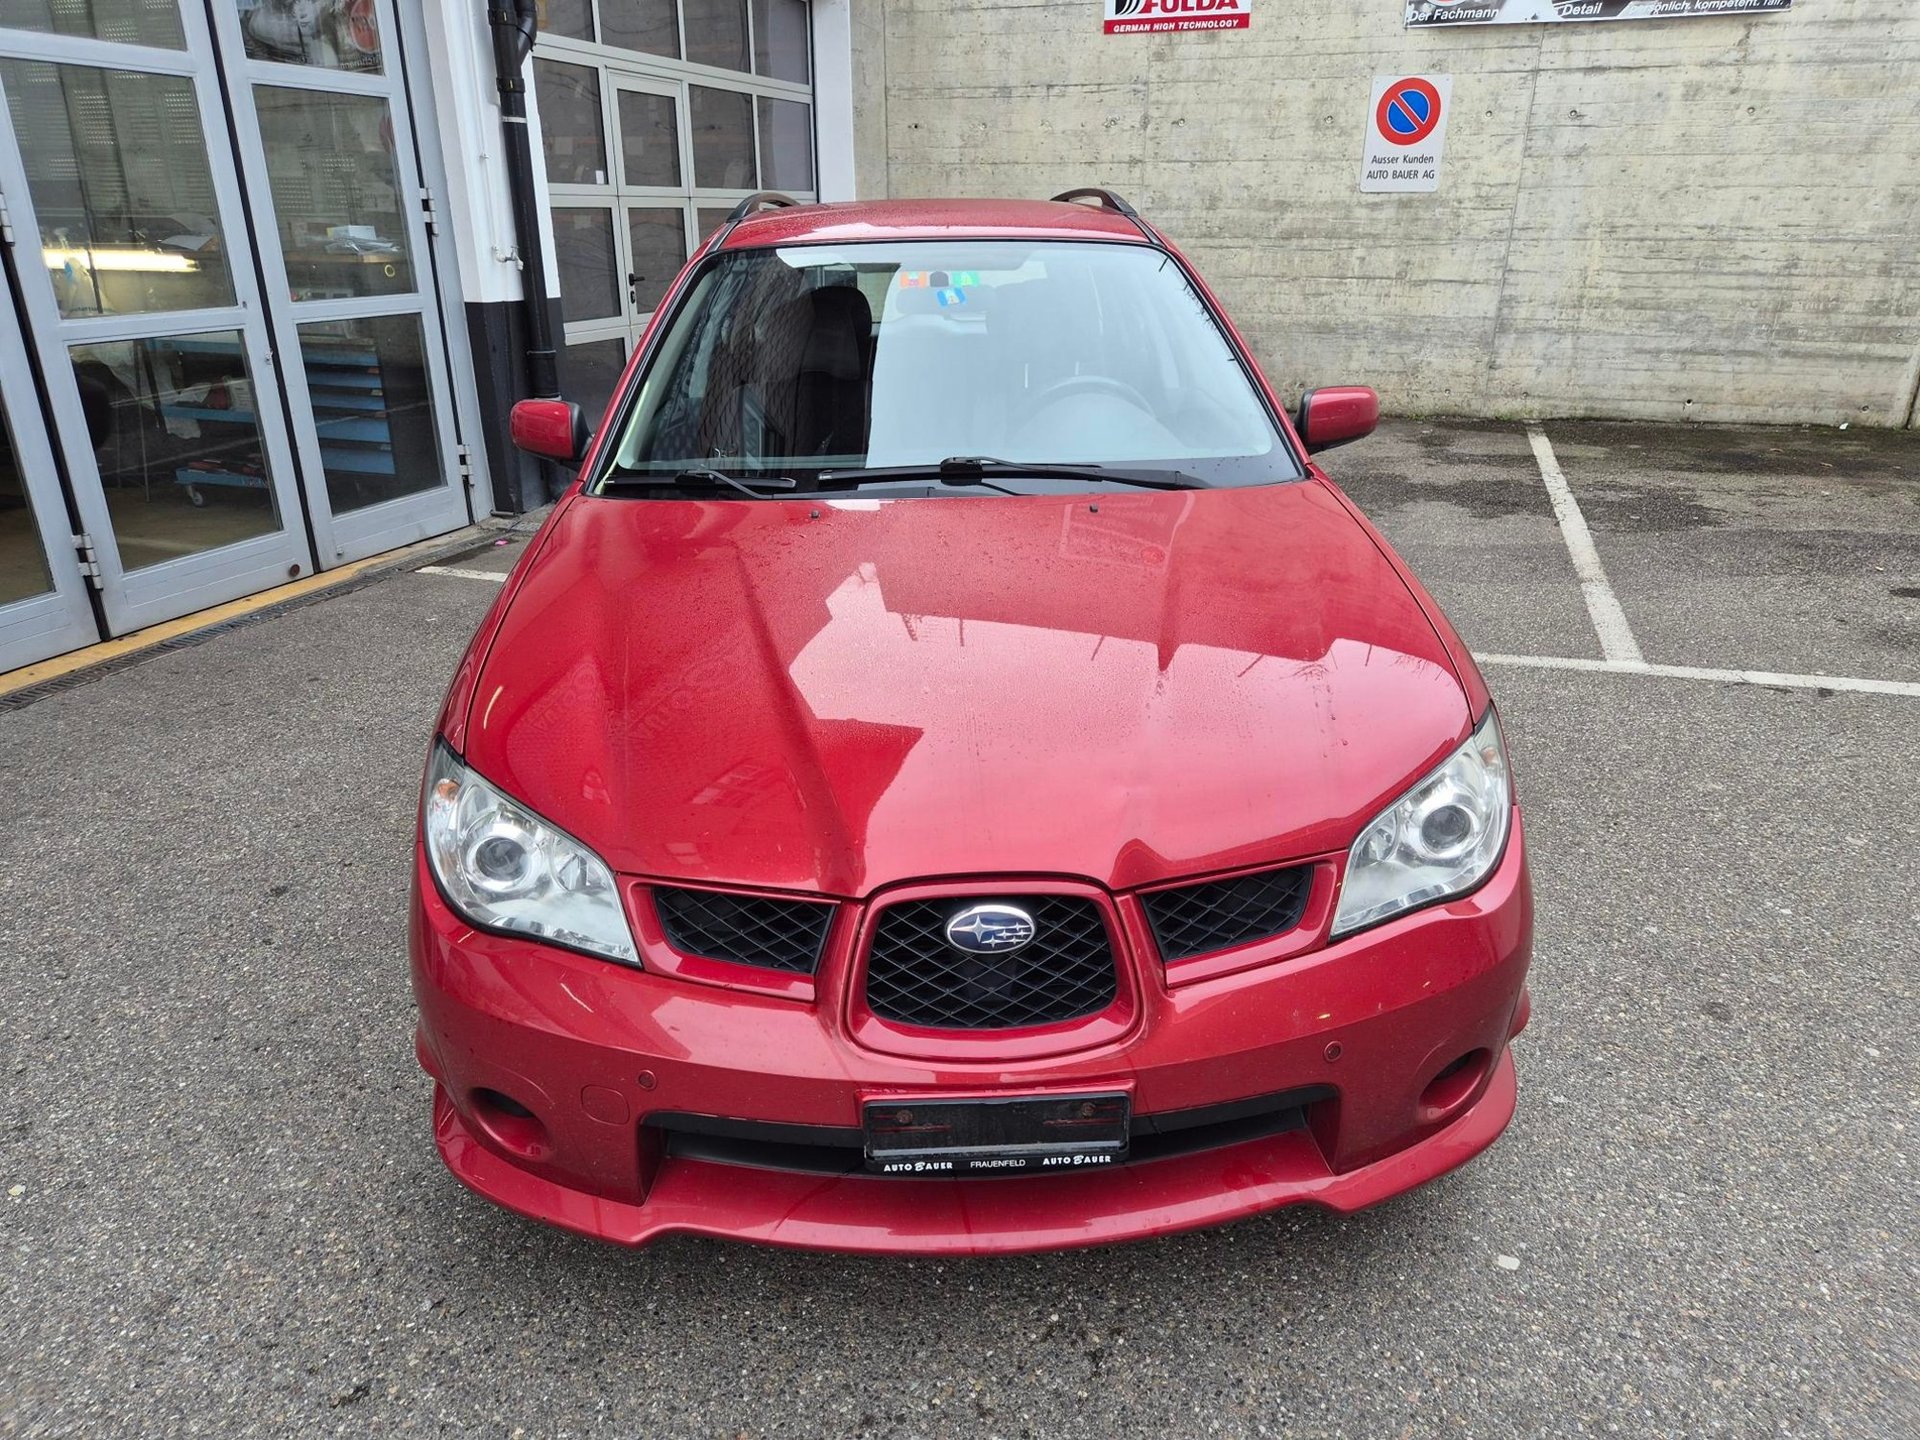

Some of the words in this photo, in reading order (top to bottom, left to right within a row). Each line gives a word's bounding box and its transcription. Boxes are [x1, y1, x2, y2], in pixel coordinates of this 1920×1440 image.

[1409, 10, 1432, 21] Der
[1433, 7, 1499, 20] Fachmann
[1562, 3, 1602, 15] Detail
[1113, 23, 1150, 33] GERMAN
[1153, 22, 1175, 31] HIGH
[1178, 19, 1239, 30] TECHNOLOGY
[1371, 154, 1399, 164] Ausser
[1402, 153, 1434, 164] Kunden
[1366, 169, 1389, 180] AUTO
[1392, 169, 1419, 179] BAUER
[1422, 169, 1435, 179] AG
[883, 1163, 913, 1172] AUTO
[970, 1159, 1026, 1168] FRAUENFELD
[1042, 1156, 1071, 1165] AUTO
